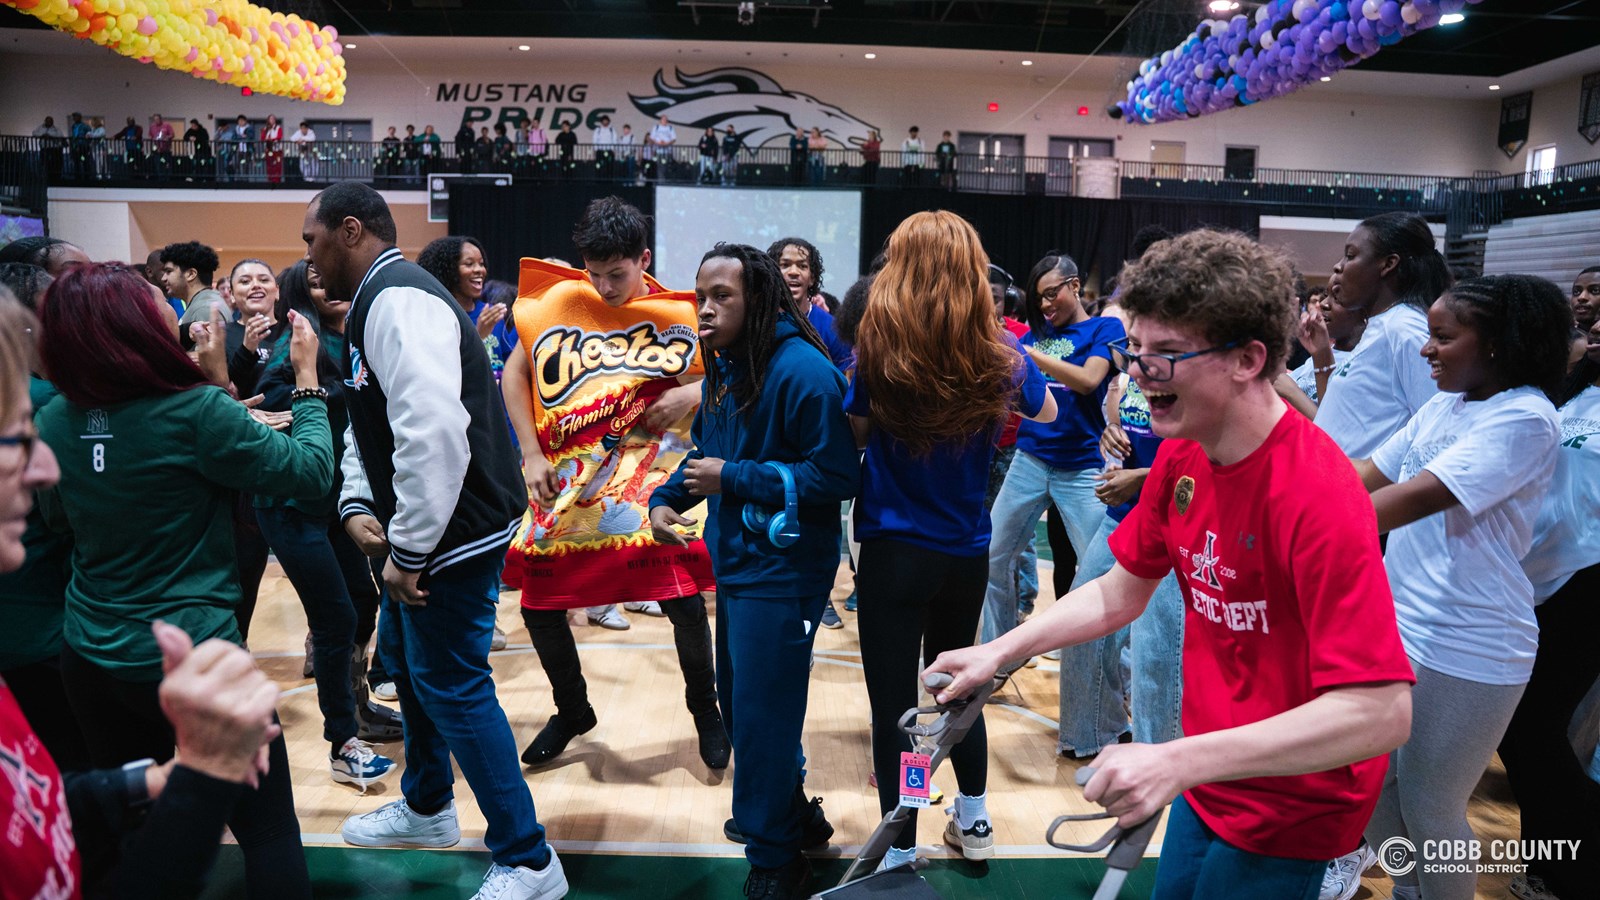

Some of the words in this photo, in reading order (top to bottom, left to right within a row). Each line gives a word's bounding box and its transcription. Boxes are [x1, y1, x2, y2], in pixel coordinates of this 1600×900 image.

[436, 83, 588, 103] MUSTANG
[460, 106, 616, 130] PRIDE
[660, 329, 676, 338] REAL
[535, 325, 690, 400] Cheetos
[558, 398, 618, 442] Flamin'
[93, 443, 105, 473] 8
[1222, 600, 1269, 634] DEPT
